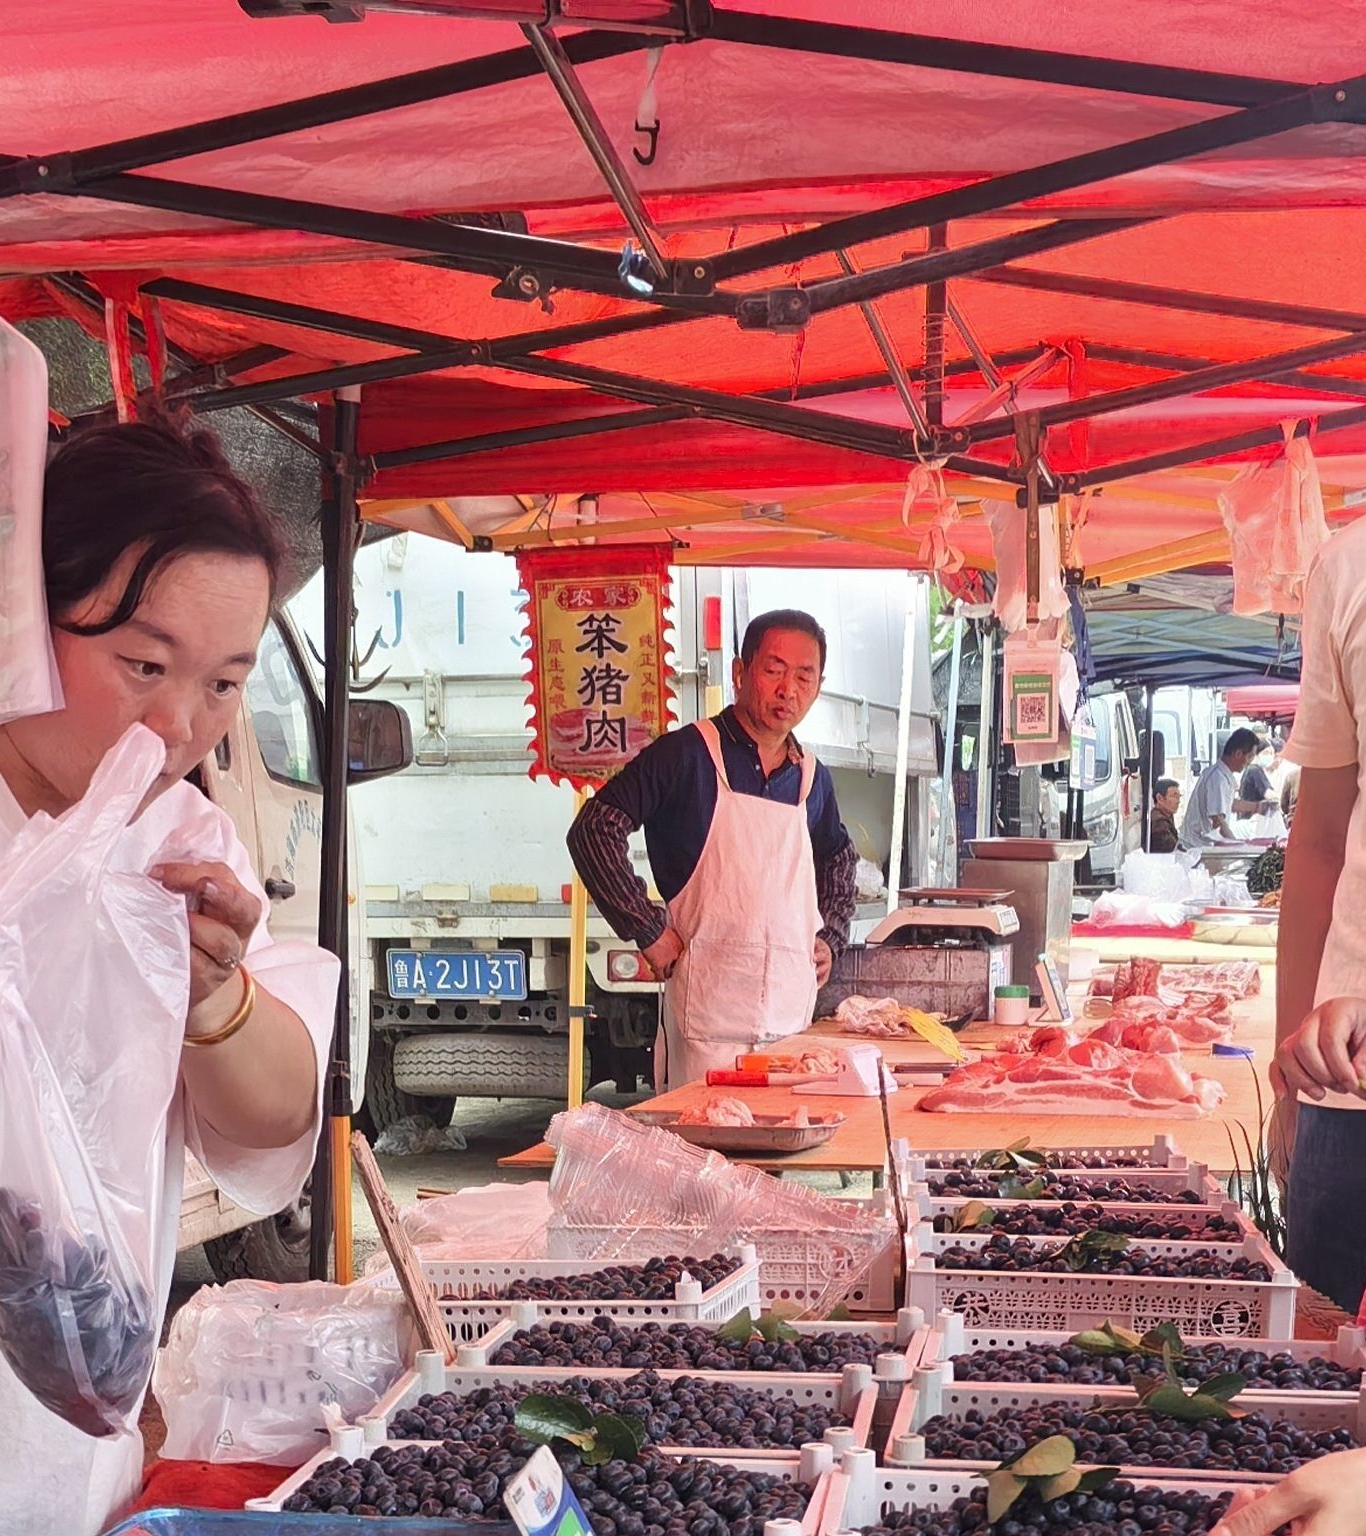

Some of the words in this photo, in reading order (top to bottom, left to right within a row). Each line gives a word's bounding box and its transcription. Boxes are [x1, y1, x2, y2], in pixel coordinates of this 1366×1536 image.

[571, 586, 626, 606] 农家
[575, 612, 629, 753] 笨猪肉
